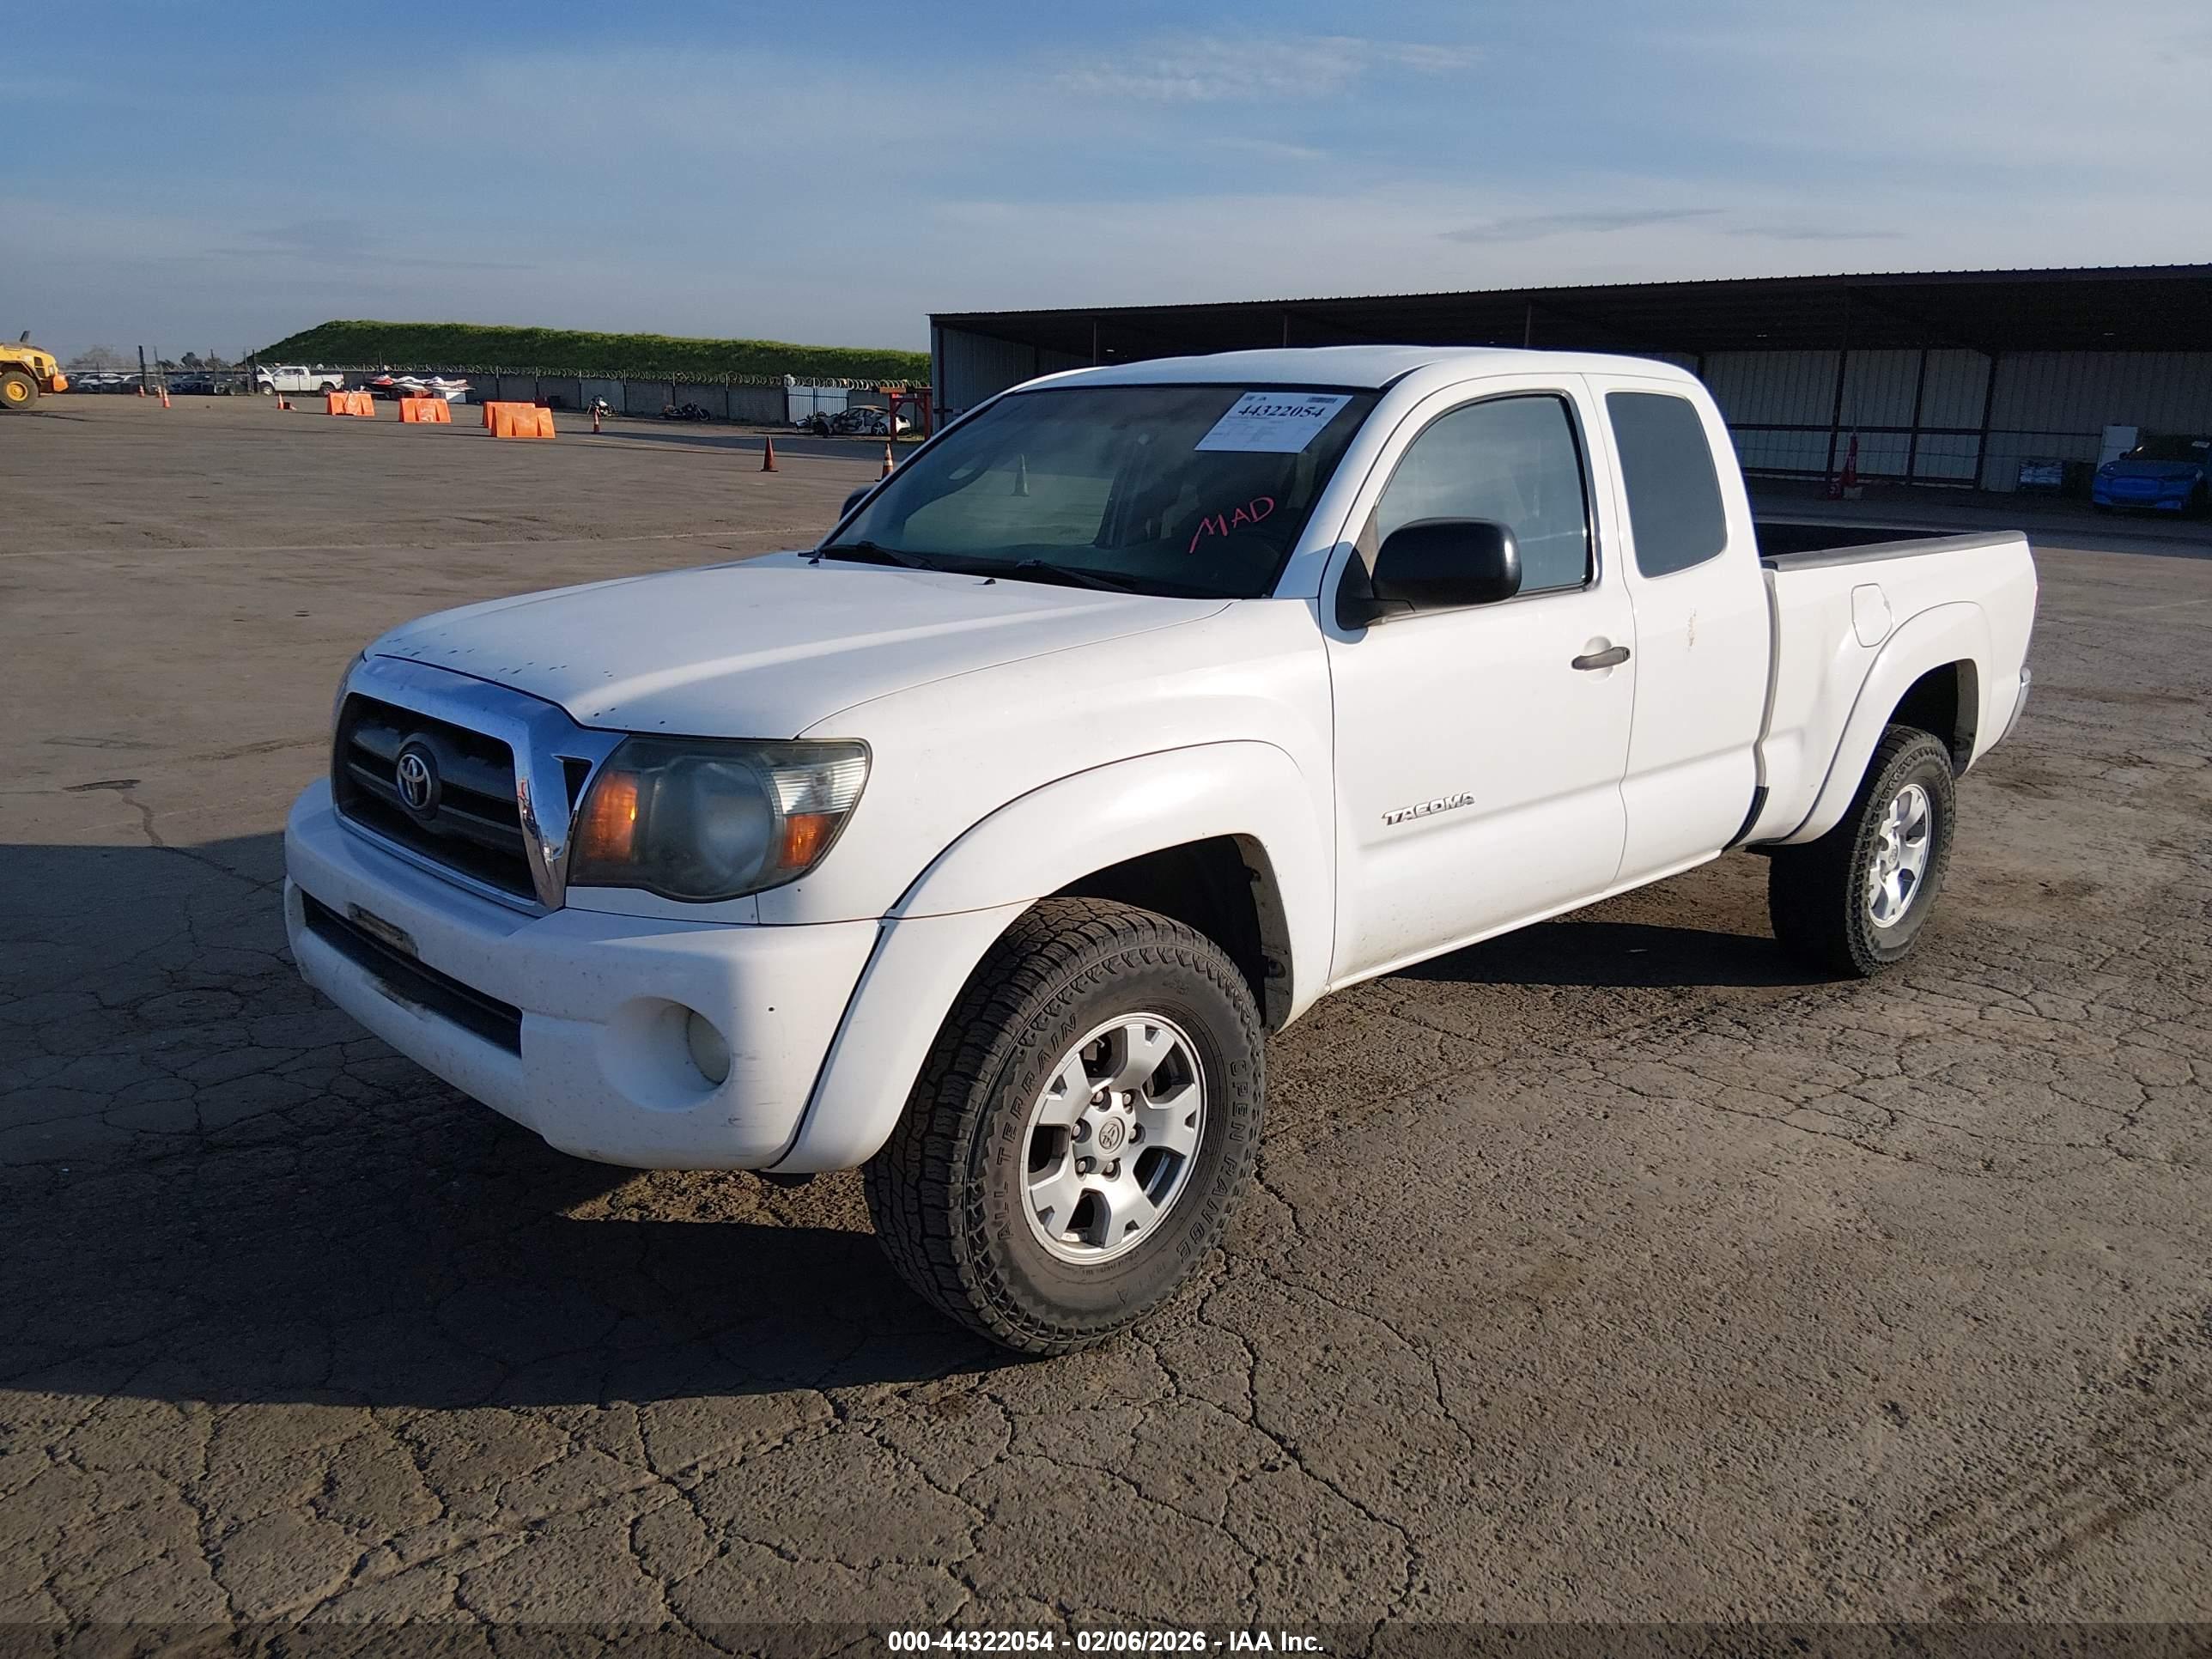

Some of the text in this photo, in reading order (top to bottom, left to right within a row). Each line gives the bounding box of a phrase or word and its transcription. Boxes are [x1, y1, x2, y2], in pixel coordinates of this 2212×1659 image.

[1238, 404, 1326, 418] 44322054
[1189, 496, 1274, 553] MAD
[1382, 791, 1475, 826] TACOMA
